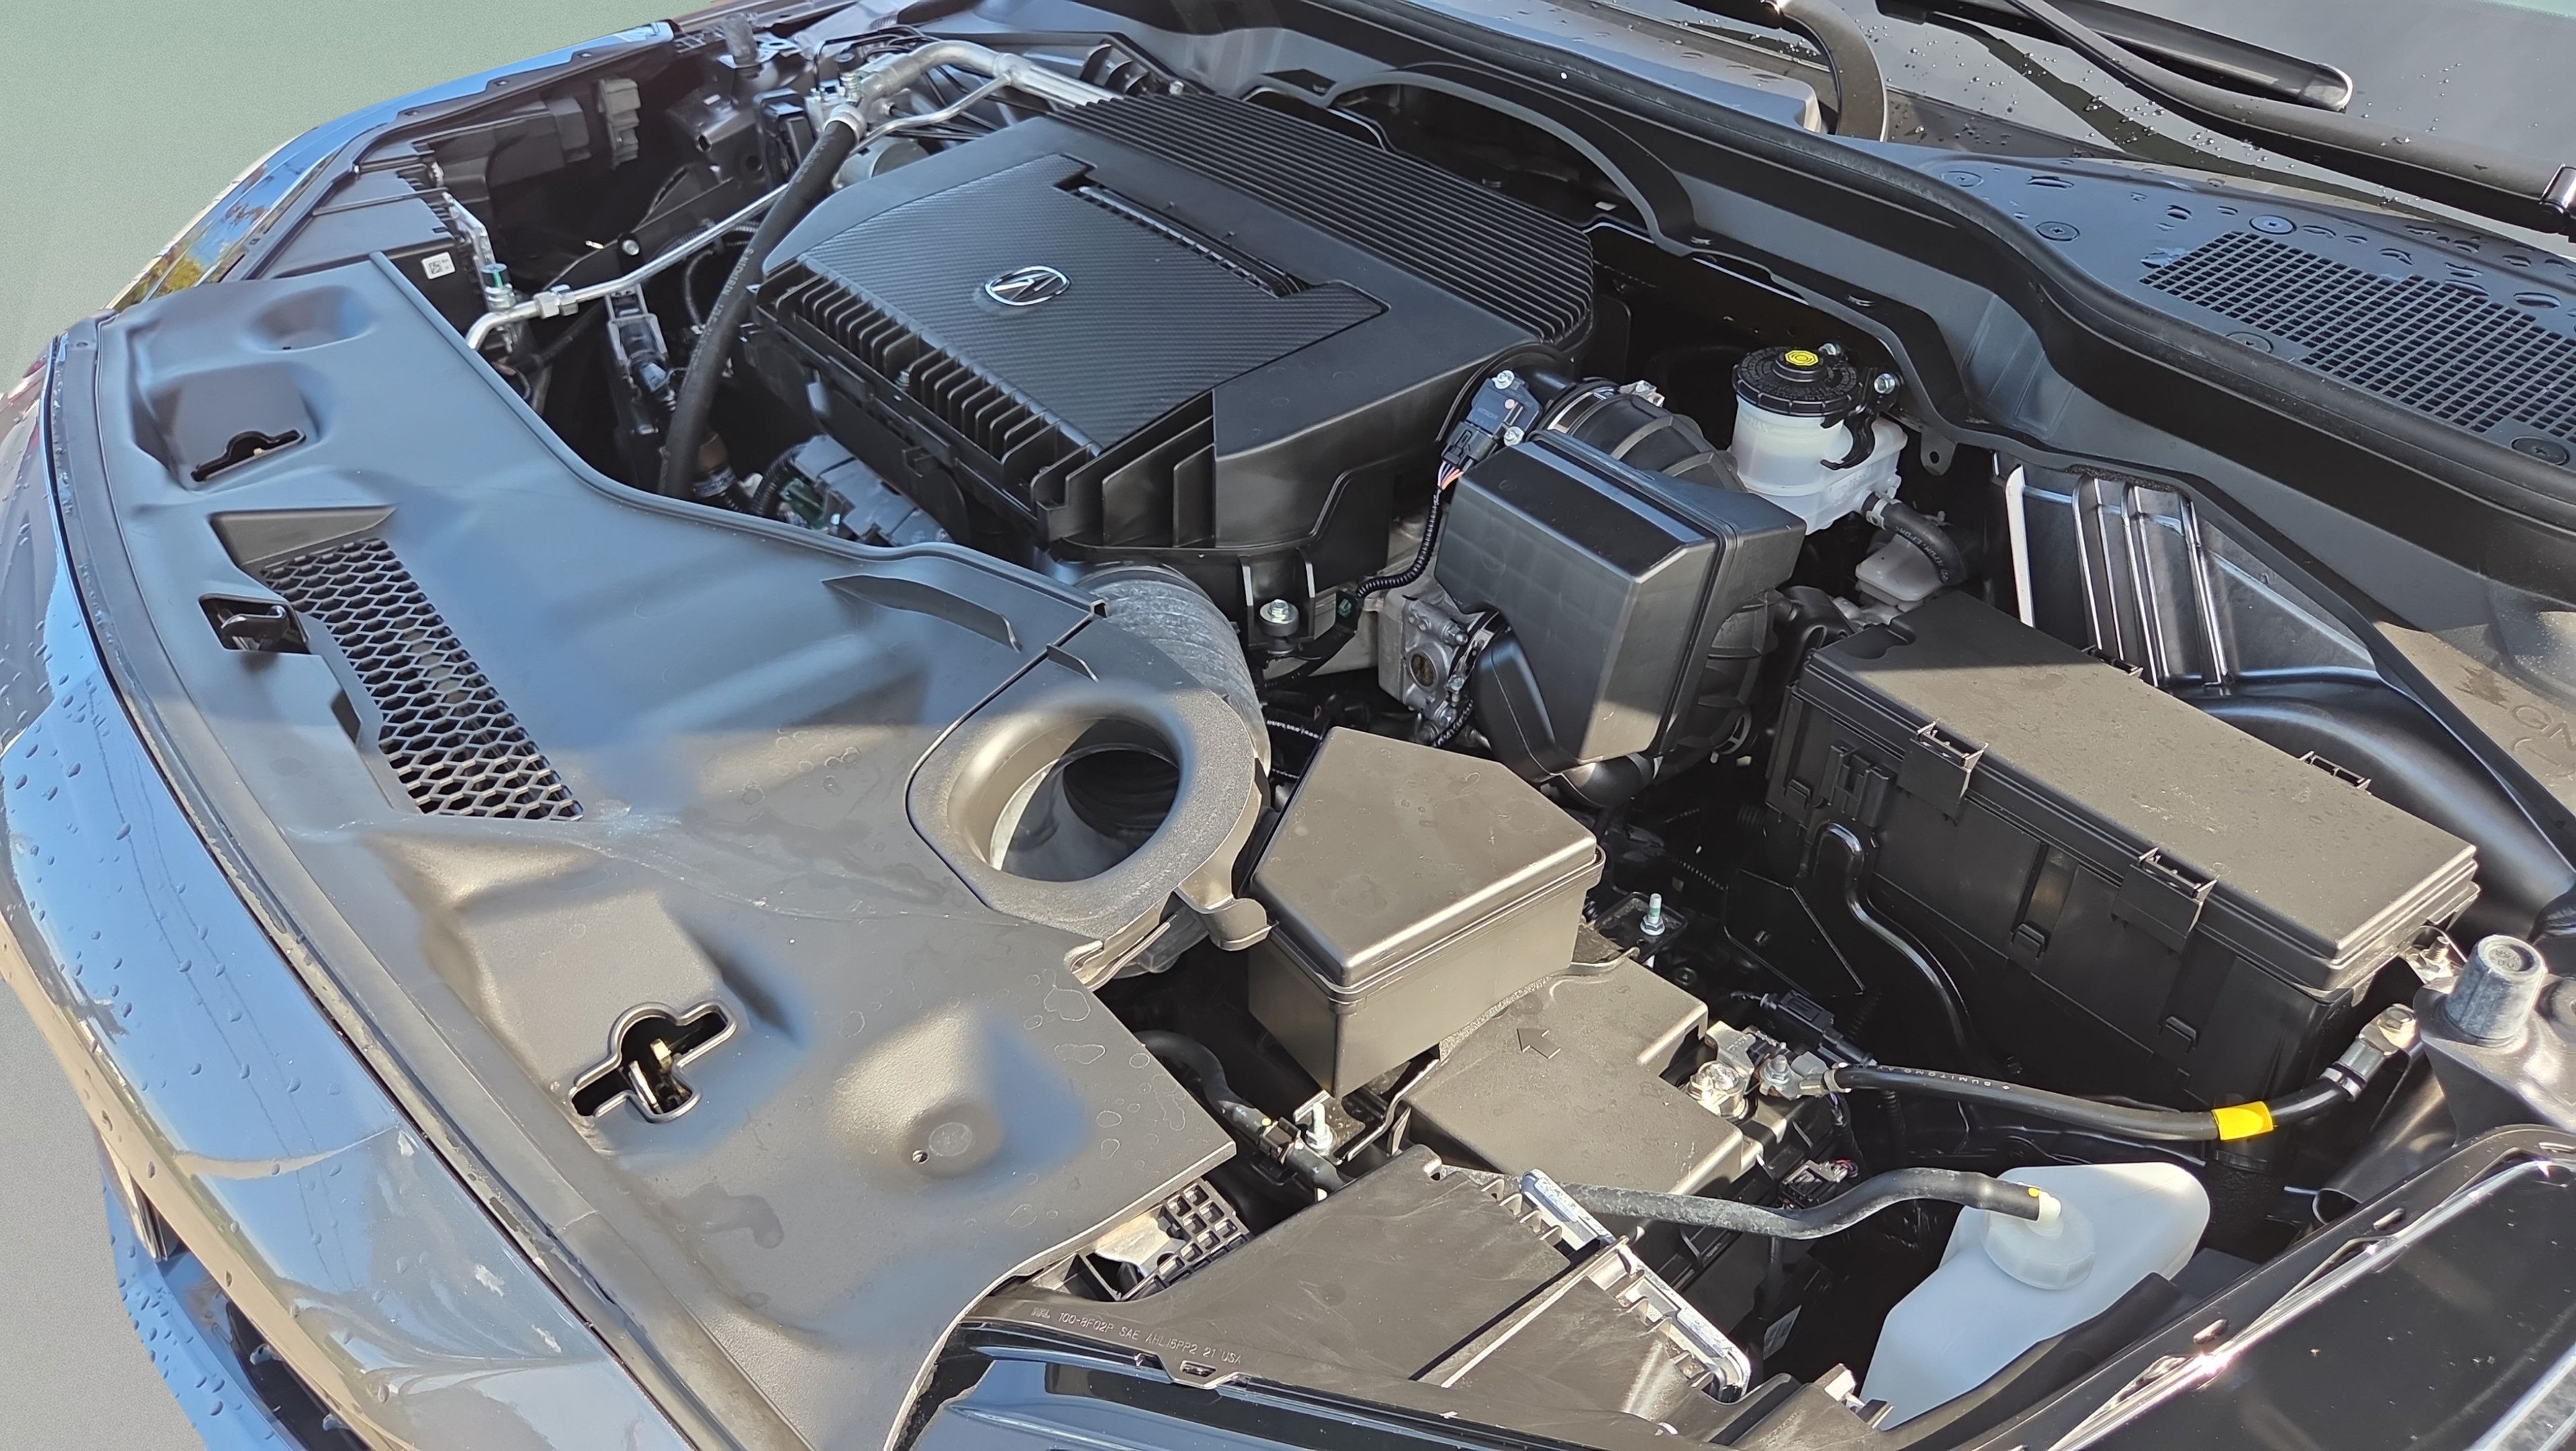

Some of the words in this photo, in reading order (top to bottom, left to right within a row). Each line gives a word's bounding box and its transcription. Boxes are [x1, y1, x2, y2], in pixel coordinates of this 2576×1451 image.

[1119, 1326, 1141, 1340] SAE
[1203, 1347, 1216, 1358] 21
[1221, 1350, 1241, 1364] USA
